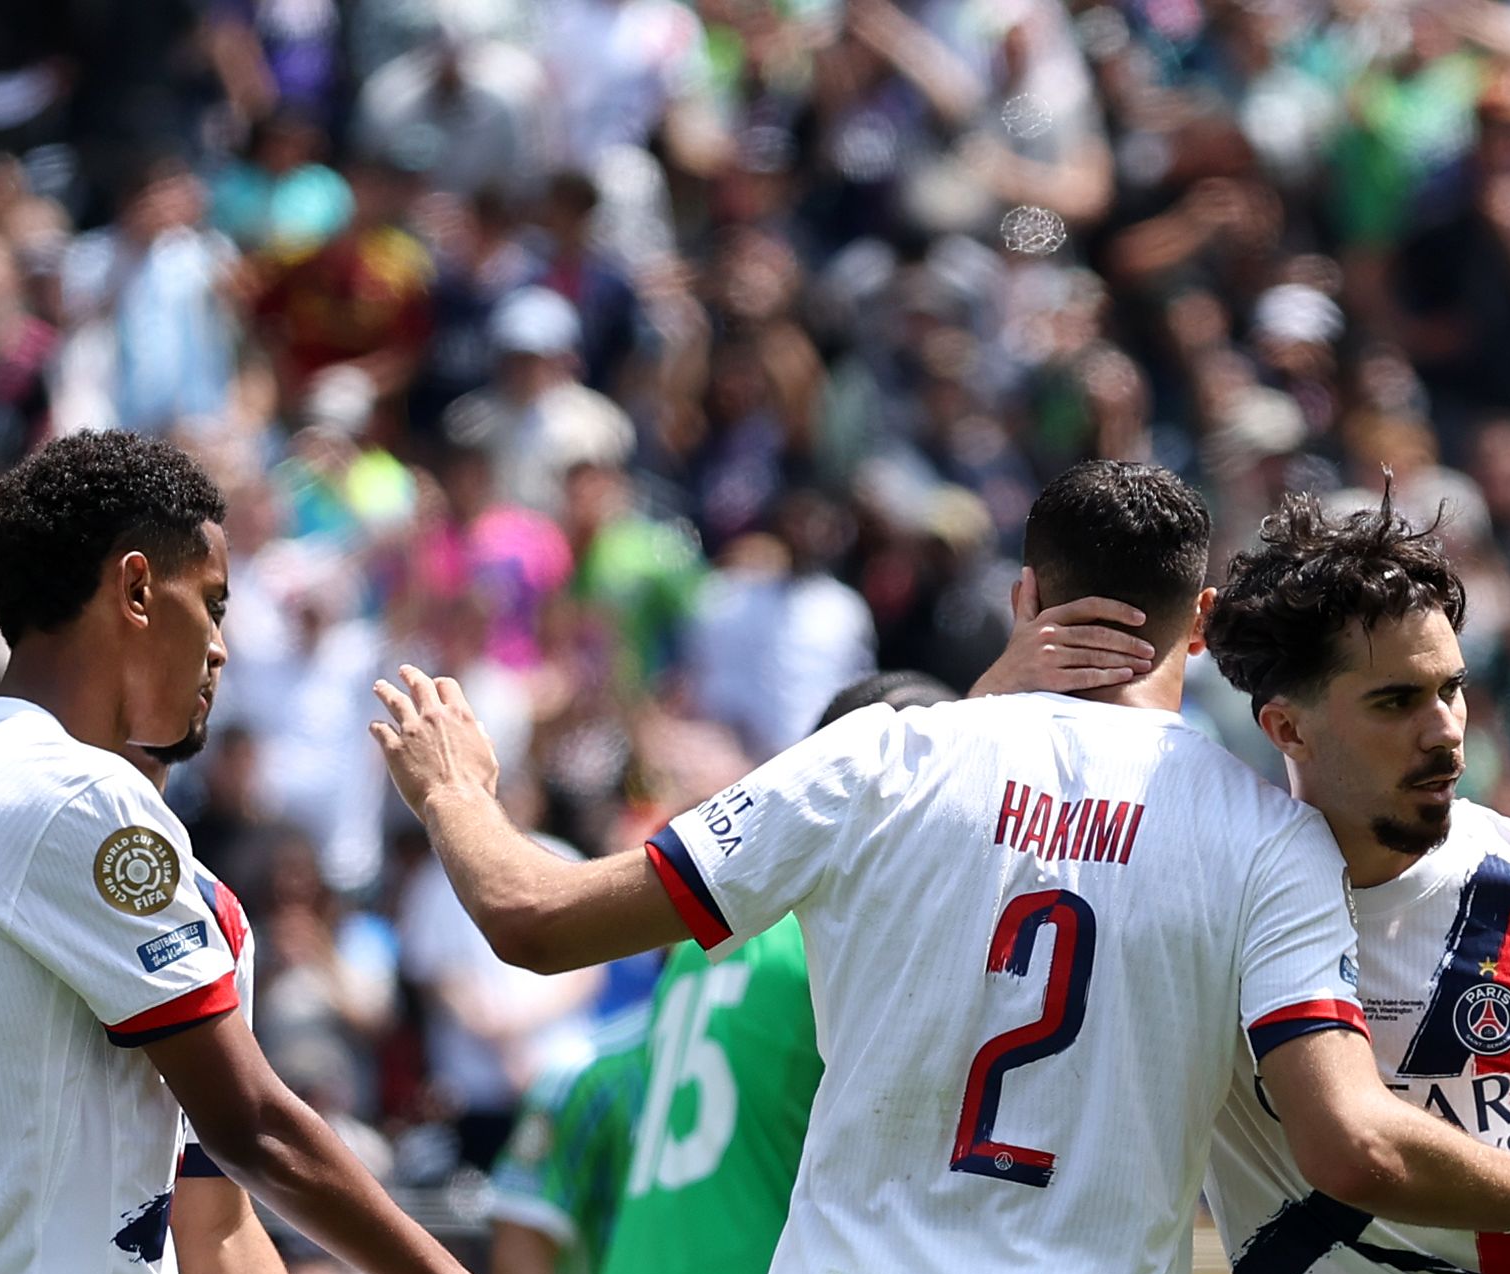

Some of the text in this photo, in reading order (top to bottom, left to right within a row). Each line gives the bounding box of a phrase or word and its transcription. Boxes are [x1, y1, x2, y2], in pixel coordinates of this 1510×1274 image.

[994, 780, 1145, 865] HAKIMI
[102, 834, 172, 903] CLUB WORLD CUP 25 USA
[133, 890, 167, 911] FIFA
[627, 961, 753, 1199] 15
[950, 889, 1096, 1188] 2
